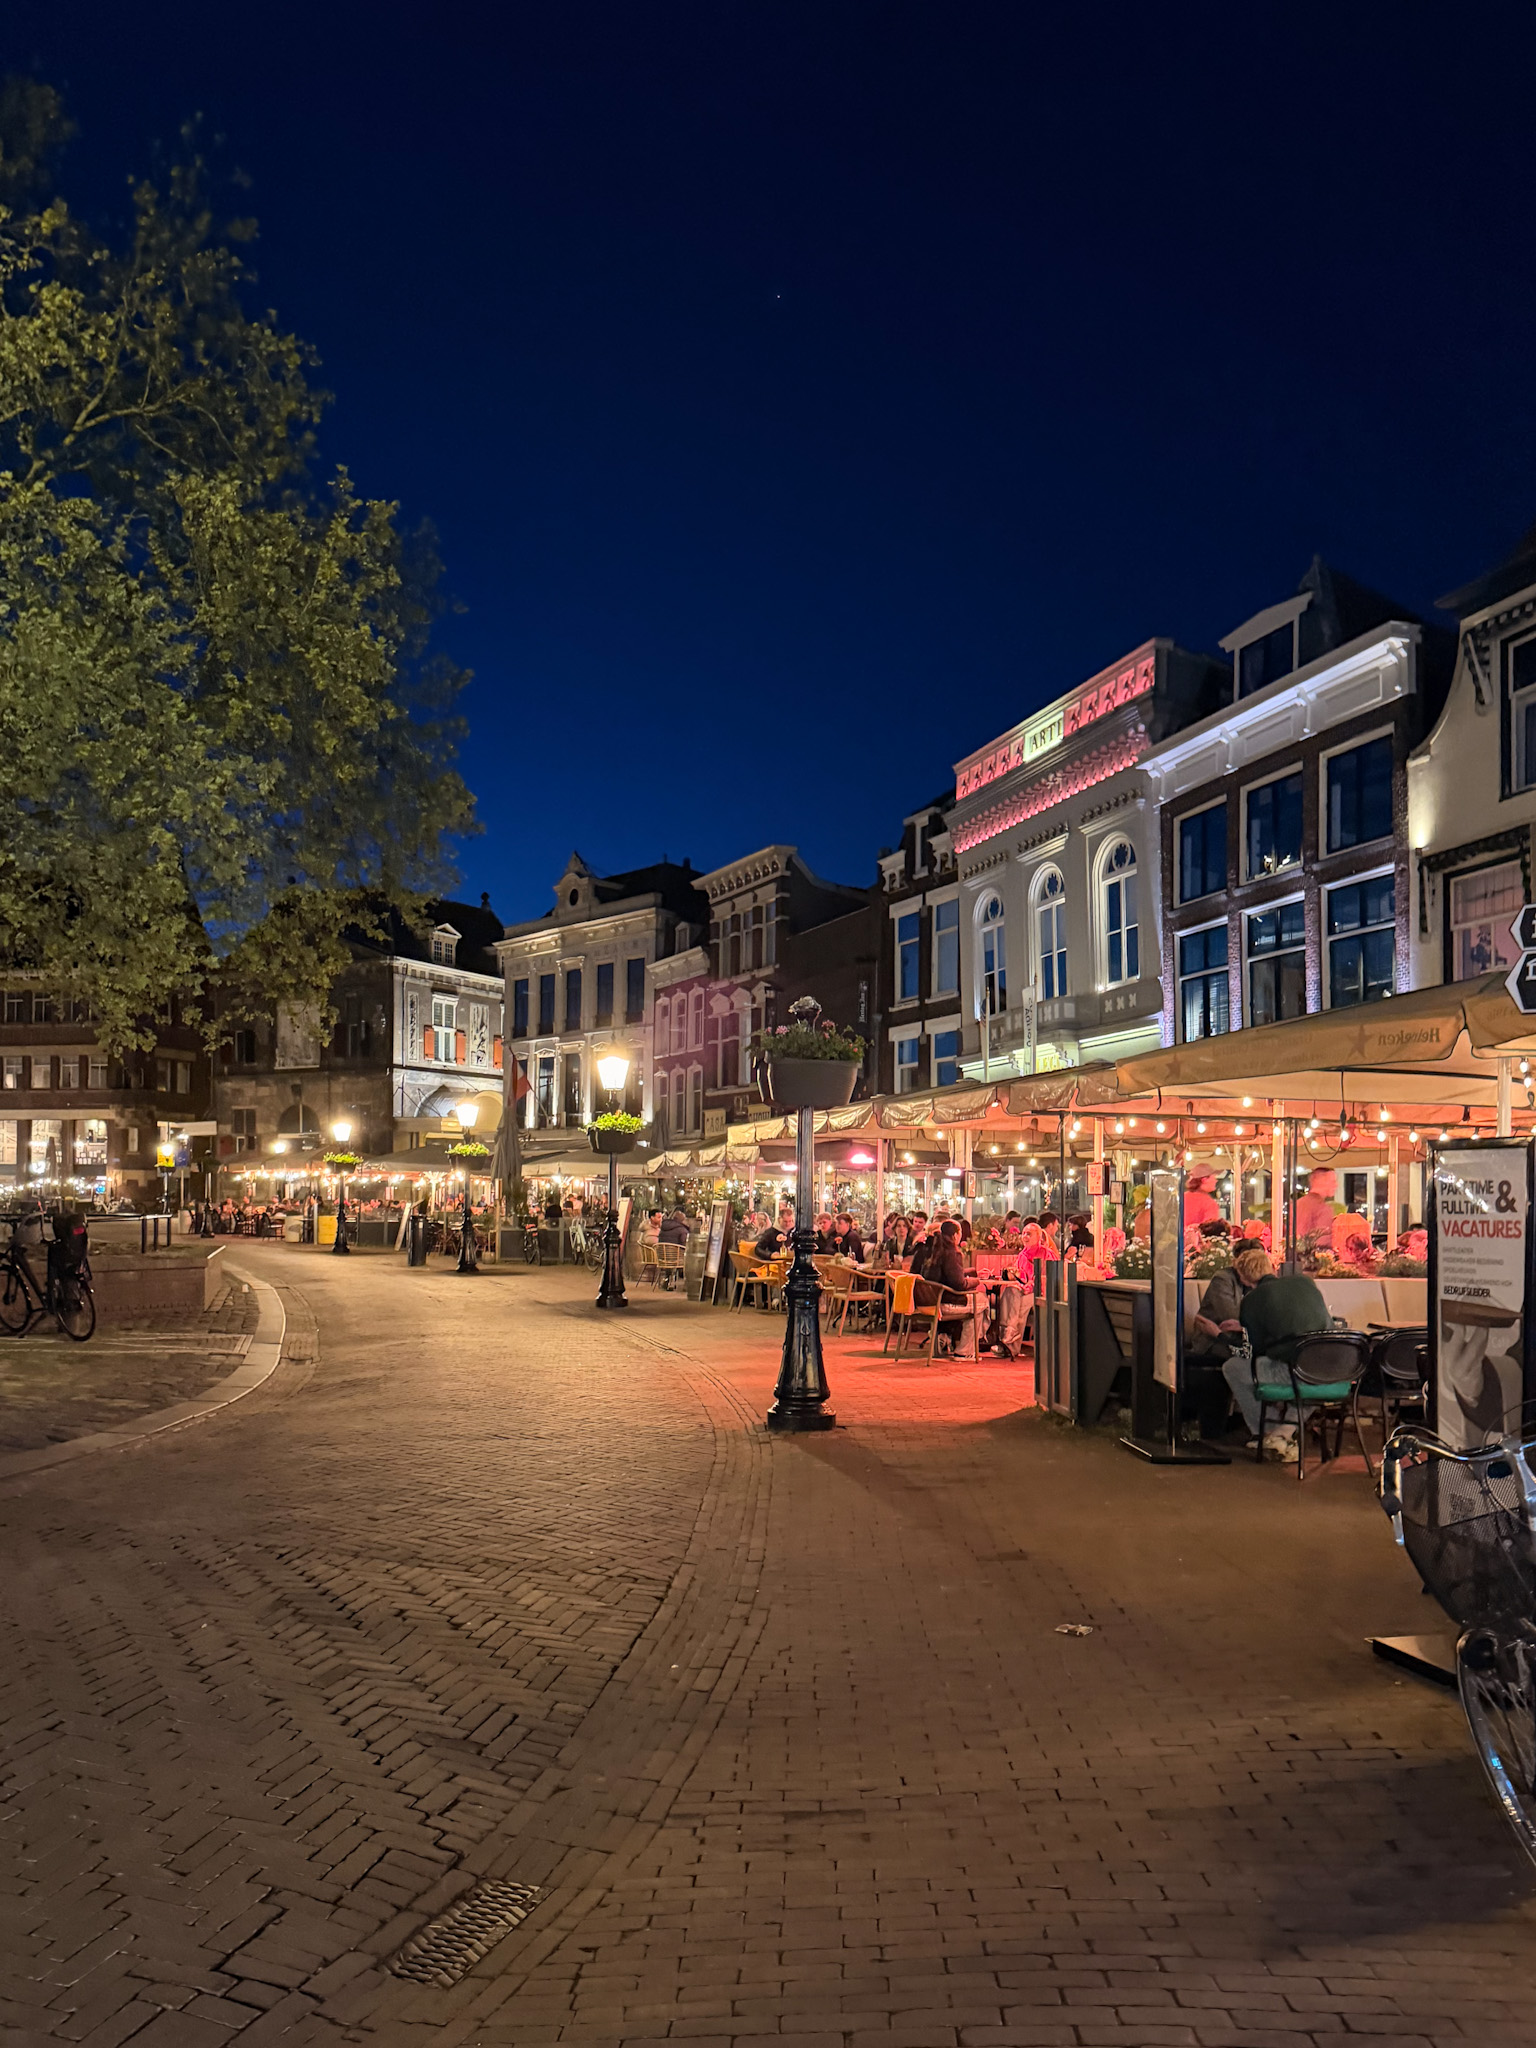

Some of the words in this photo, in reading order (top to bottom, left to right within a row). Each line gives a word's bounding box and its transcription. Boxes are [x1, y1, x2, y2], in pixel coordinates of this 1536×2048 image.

[1030, 718, 1063, 752] ARTI
[1495, 1179, 1518, 1213] &
[1441, 1219, 1522, 1239] VACATURES
